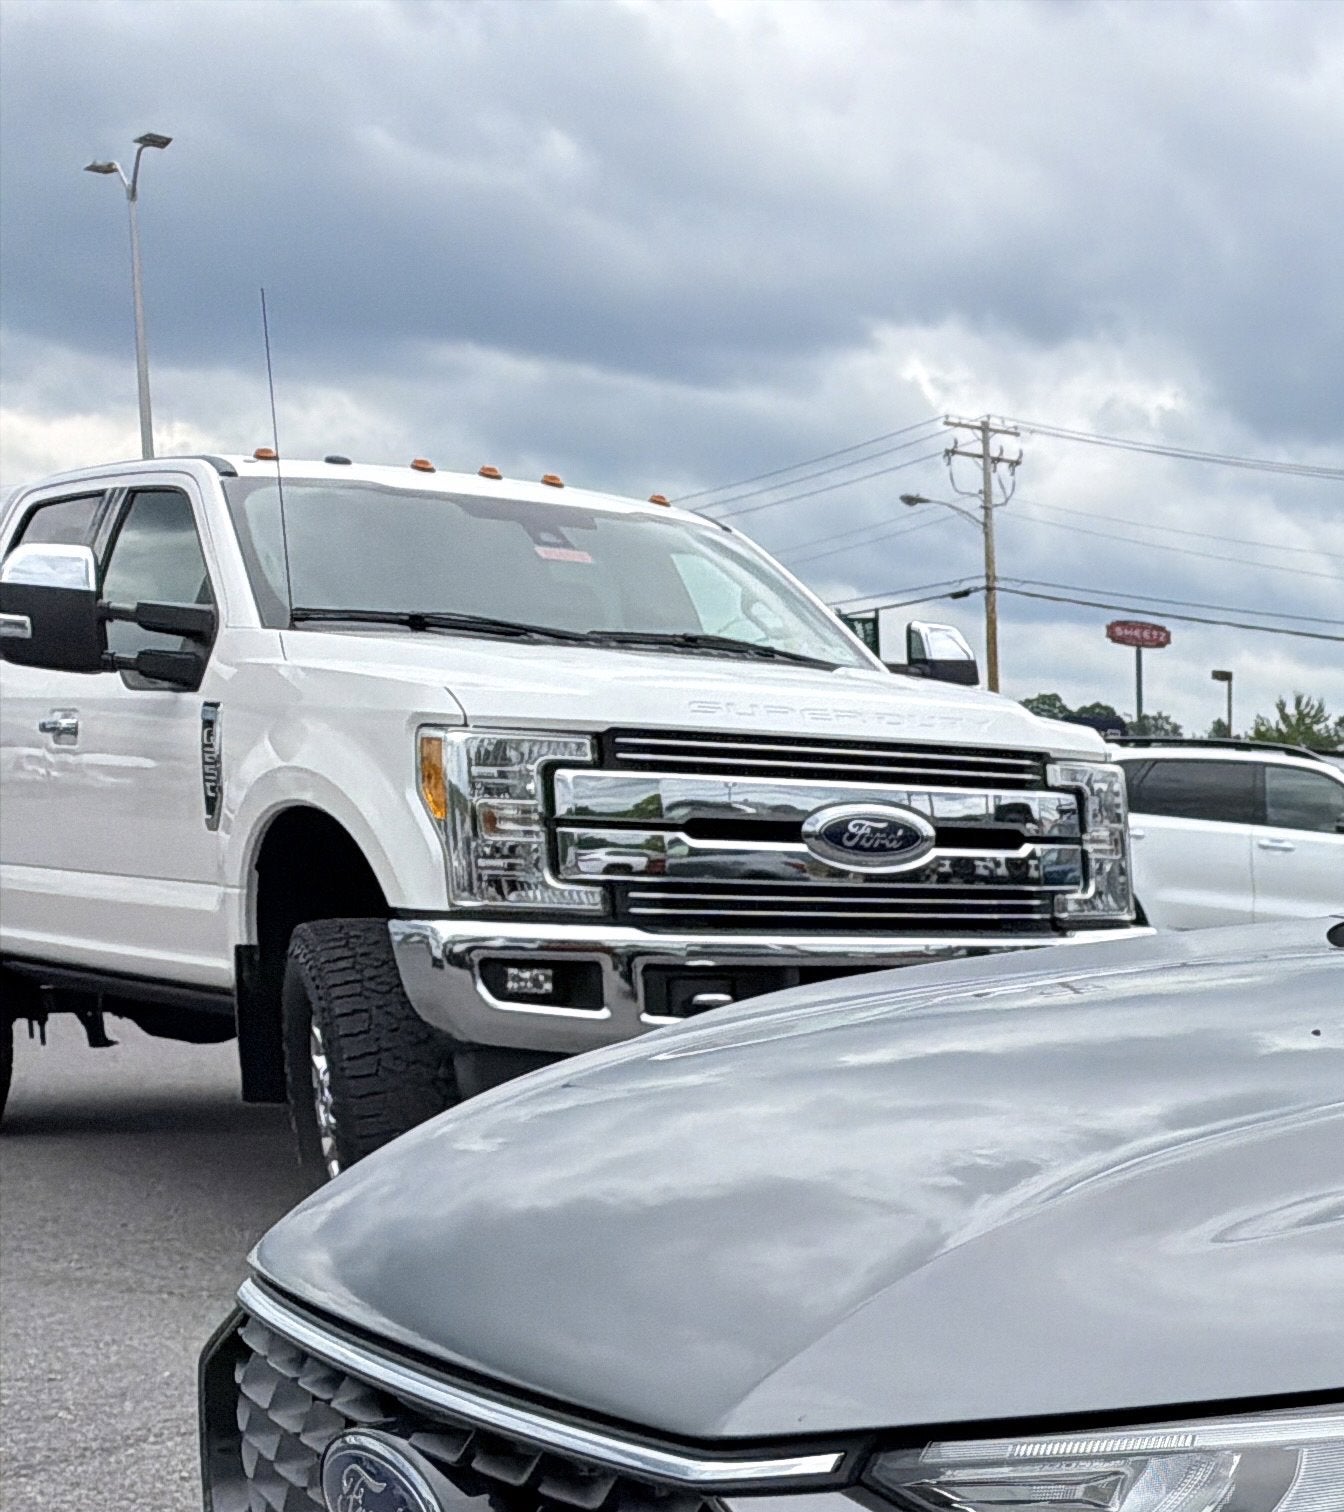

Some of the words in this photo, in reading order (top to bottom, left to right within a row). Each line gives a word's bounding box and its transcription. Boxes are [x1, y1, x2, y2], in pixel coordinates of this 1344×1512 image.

[1114, 626, 1167, 642] SHEETZ
[688, 700, 867, 722] SUPER
[842, 819, 904, 850] Ford
